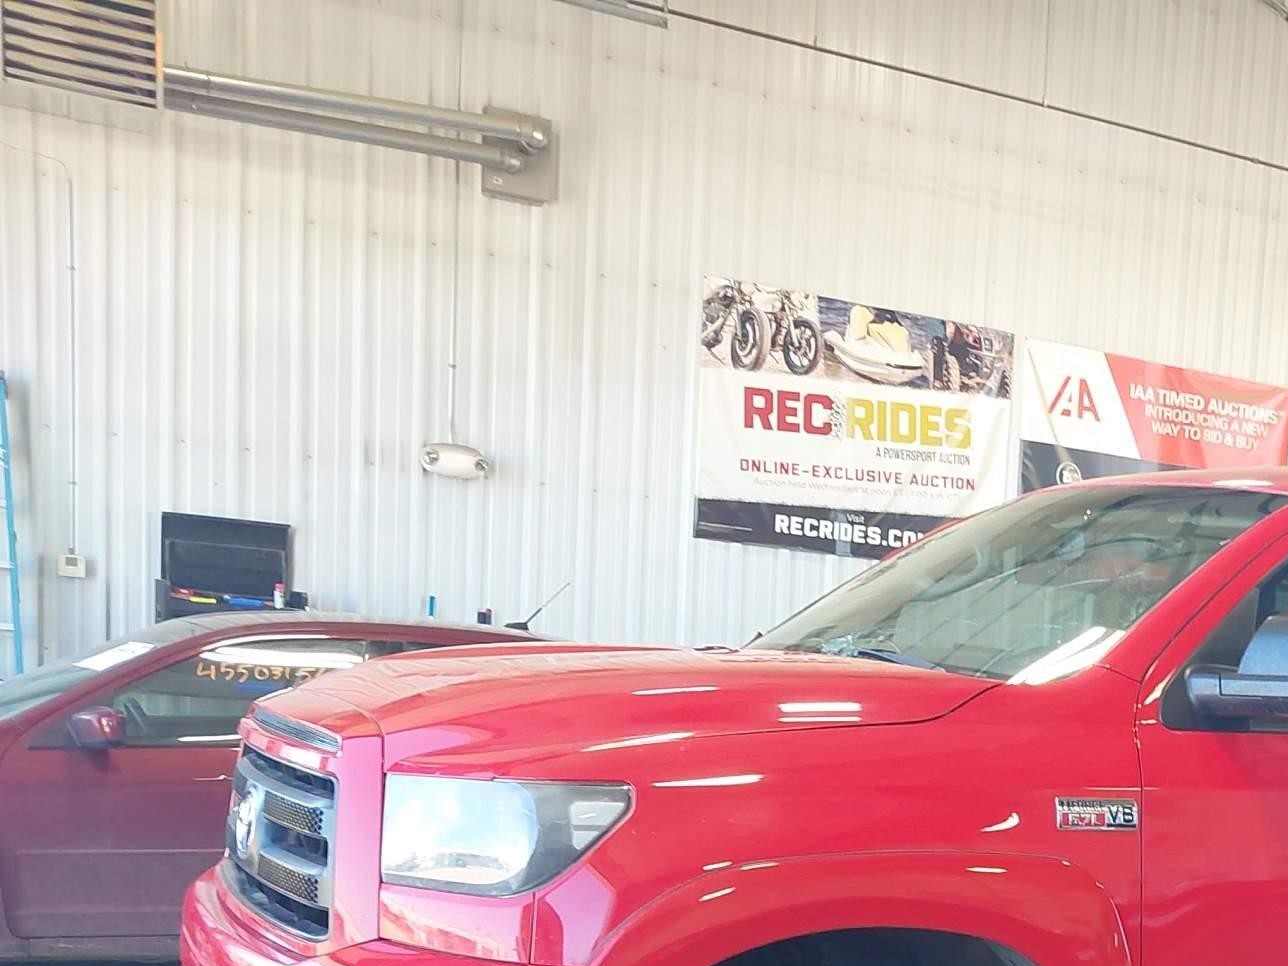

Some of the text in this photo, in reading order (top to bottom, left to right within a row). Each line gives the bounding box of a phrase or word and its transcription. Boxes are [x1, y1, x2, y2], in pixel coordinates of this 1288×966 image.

[1129, 383, 1155, 402] IAA
[1157, 388, 1206, 411] TIMED
[743, 386, 972, 450] REC RIDES
[1144, 403, 1270, 440] INTRODUCING A NEW
[1151, 420, 1262, 451] WAY TO BID & BUY
[875, 446, 971, 467] A POWERSPORT AUCTION
[739, 458, 976, 492] ONLINE-EXCLUSIVE AUCTION
[774, 513, 926, 549] RECRIDES.CO
[846, 512, 866, 525] Visit
